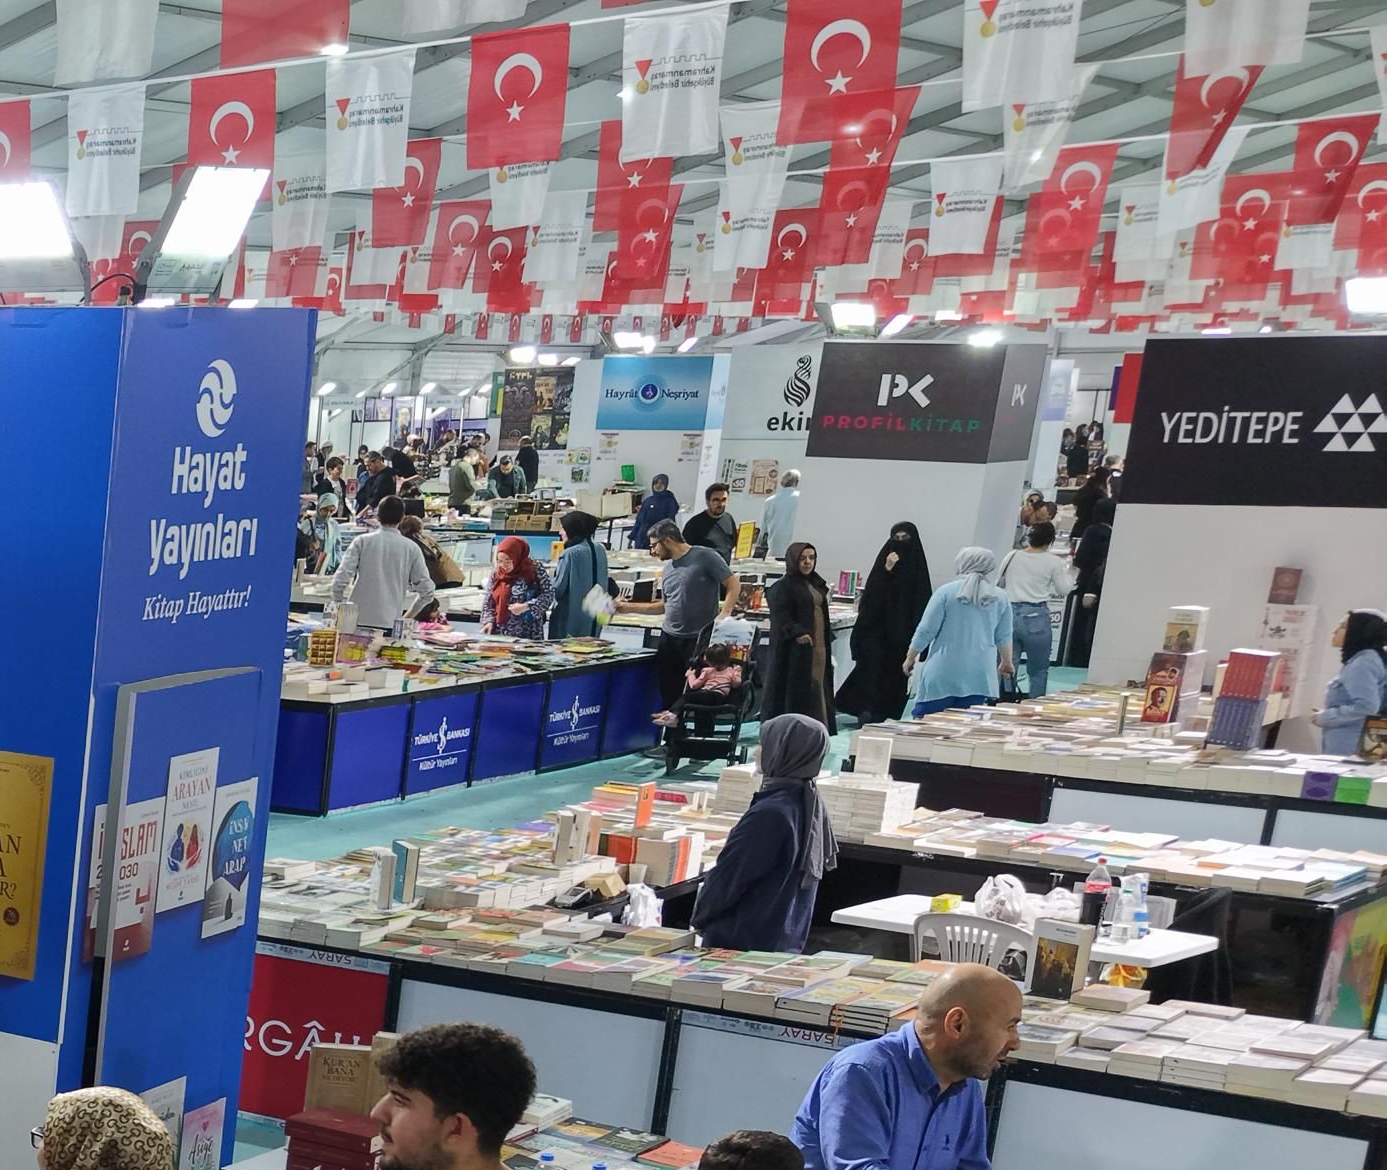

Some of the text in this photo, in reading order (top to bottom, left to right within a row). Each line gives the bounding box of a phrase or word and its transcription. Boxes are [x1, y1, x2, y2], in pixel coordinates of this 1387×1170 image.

[661, 387, 700, 403] Neşriyat
[1160, 405, 1304, 445] YEDİTEPE
[171, 443, 247, 508] Hayat
[149, 512, 258, 580] Yayınları
[142, 585, 251, 625] Kitap Hayattır!
[549, 704, 601, 723] TÜRKİYE BANKASI
[414, 727, 471, 746] TÜRKİYE BANKASI
[173, 777, 212, 802] ARAYAN
[311, 950, 352, 965] SARAY
[780, 1026, 834, 1045] SARAY
[327, 1066, 355, 1077] BANA
